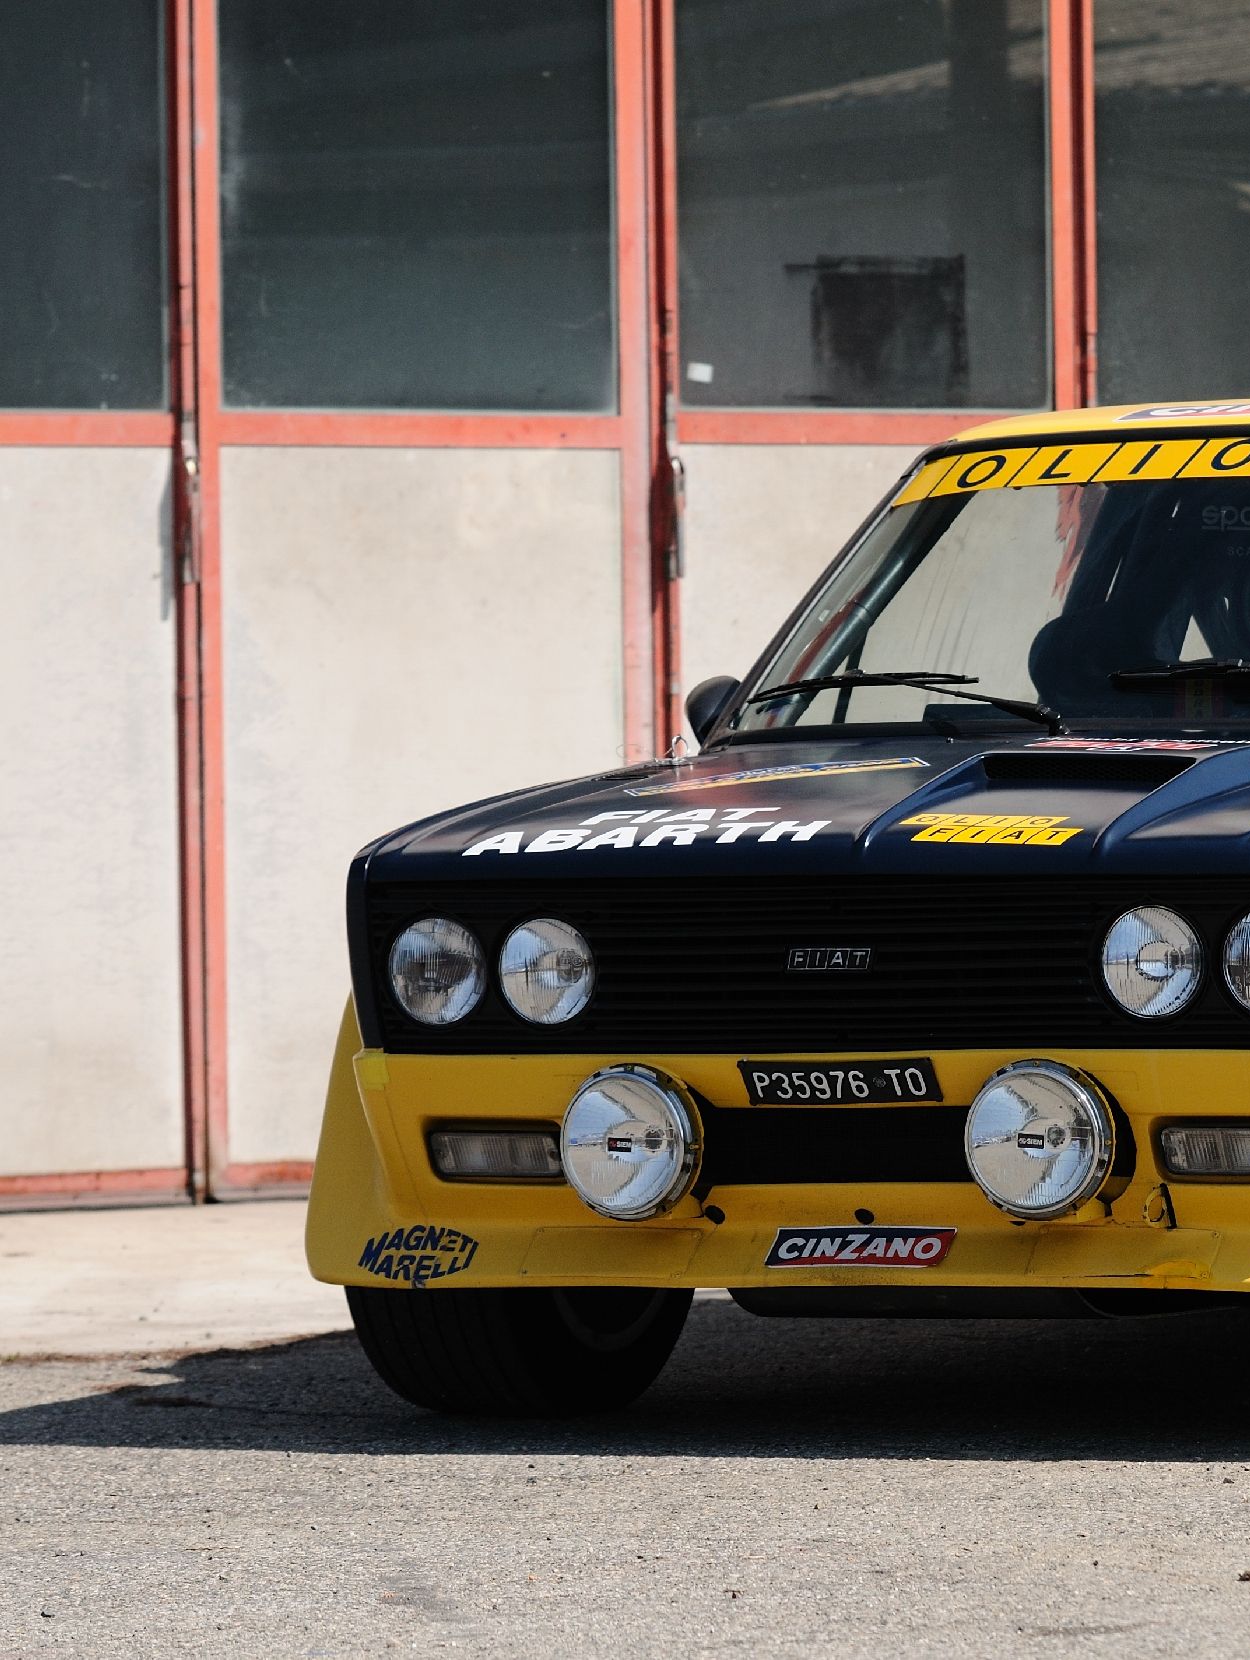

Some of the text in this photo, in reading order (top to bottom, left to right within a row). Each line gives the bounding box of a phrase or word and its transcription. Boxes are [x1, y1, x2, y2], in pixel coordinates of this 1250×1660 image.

[578, 806, 782, 826] FIAT
[915, 815, 1051, 826] OLIO
[461, 820, 832, 857] ABARTH
[928, 827, 1068, 841] FIAT
[793, 951, 866, 966] FIAT
[752, 1068, 927, 1099] P35976 TO
[358, 1224, 480, 1266] MAGNETI
[778, 1234, 942, 1260] CINZANO
[358, 1238, 476, 1281] MARELLI
